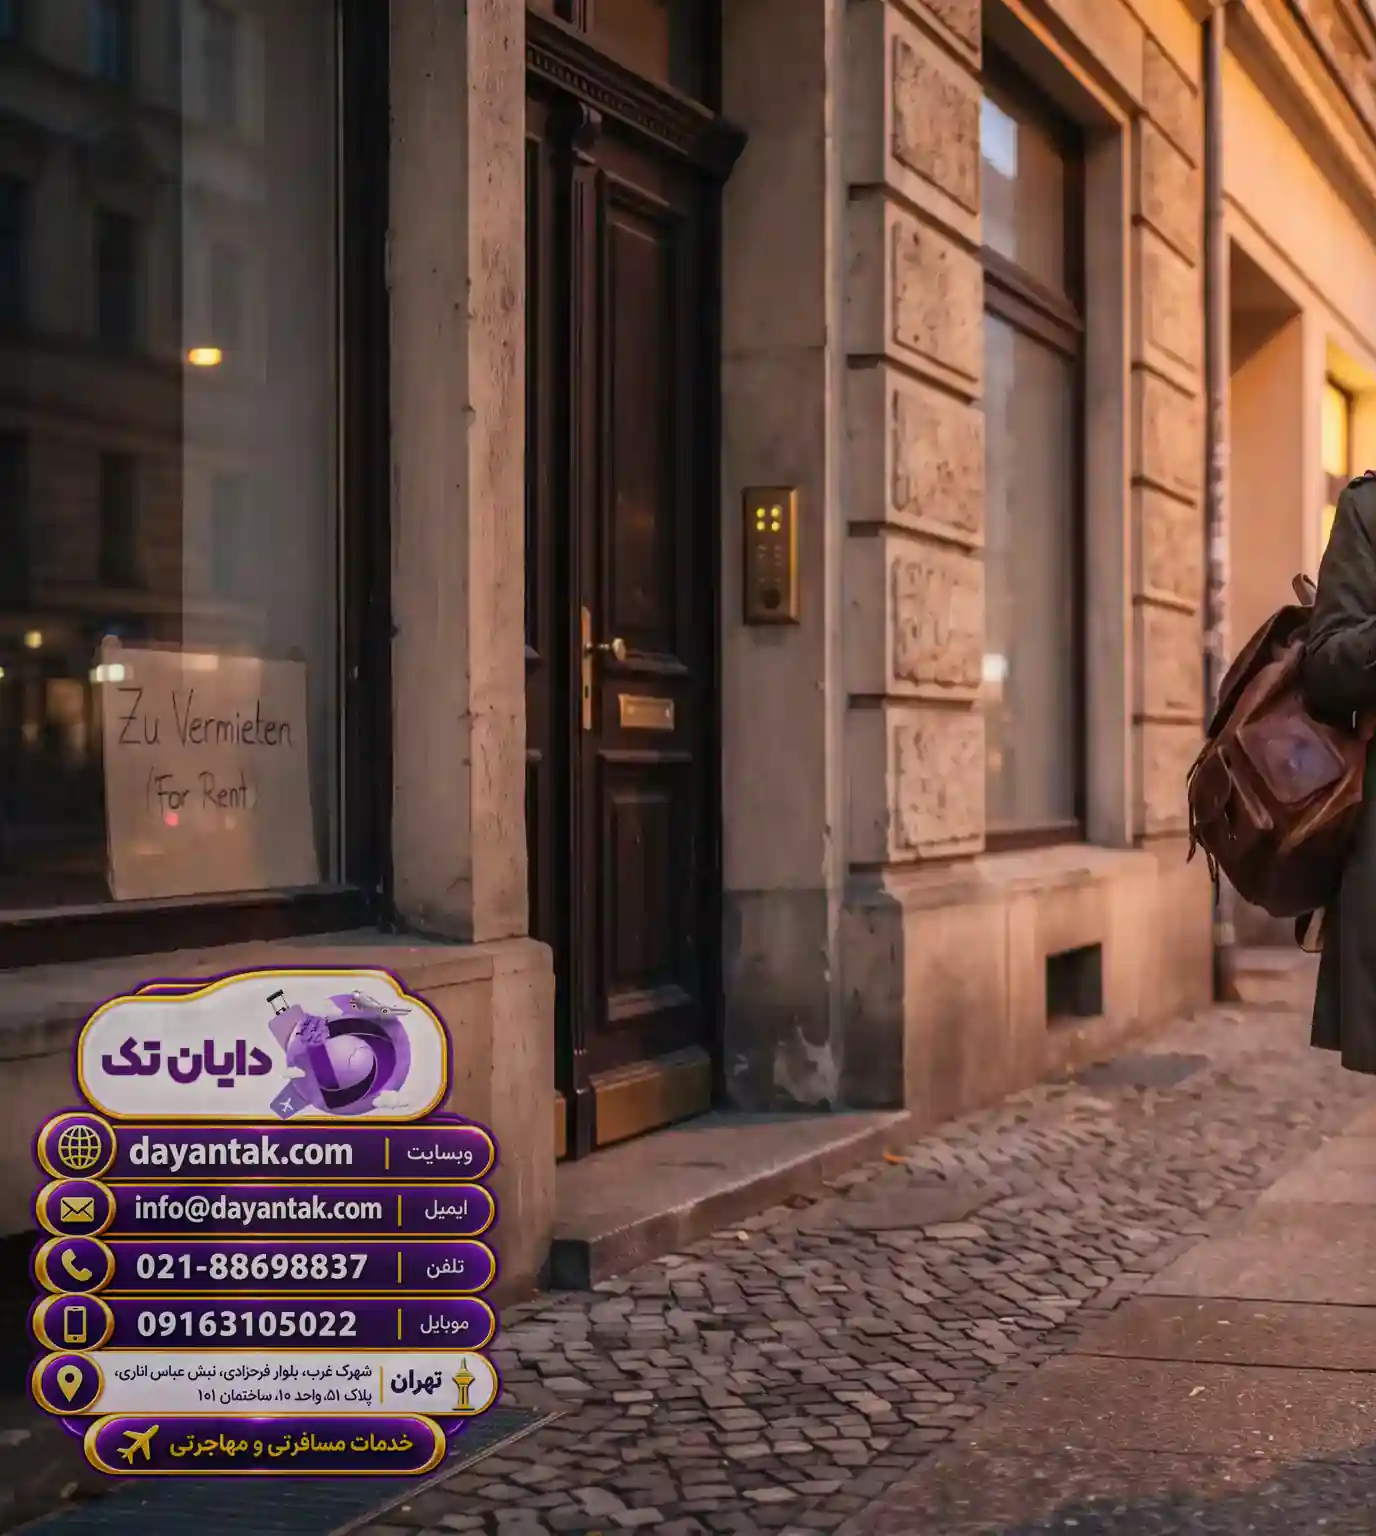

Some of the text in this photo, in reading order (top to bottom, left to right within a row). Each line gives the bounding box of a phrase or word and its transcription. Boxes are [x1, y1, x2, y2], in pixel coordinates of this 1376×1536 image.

[116, 687, 293, 747] Zu Vermieten
[146, 766, 191, 816] (For
